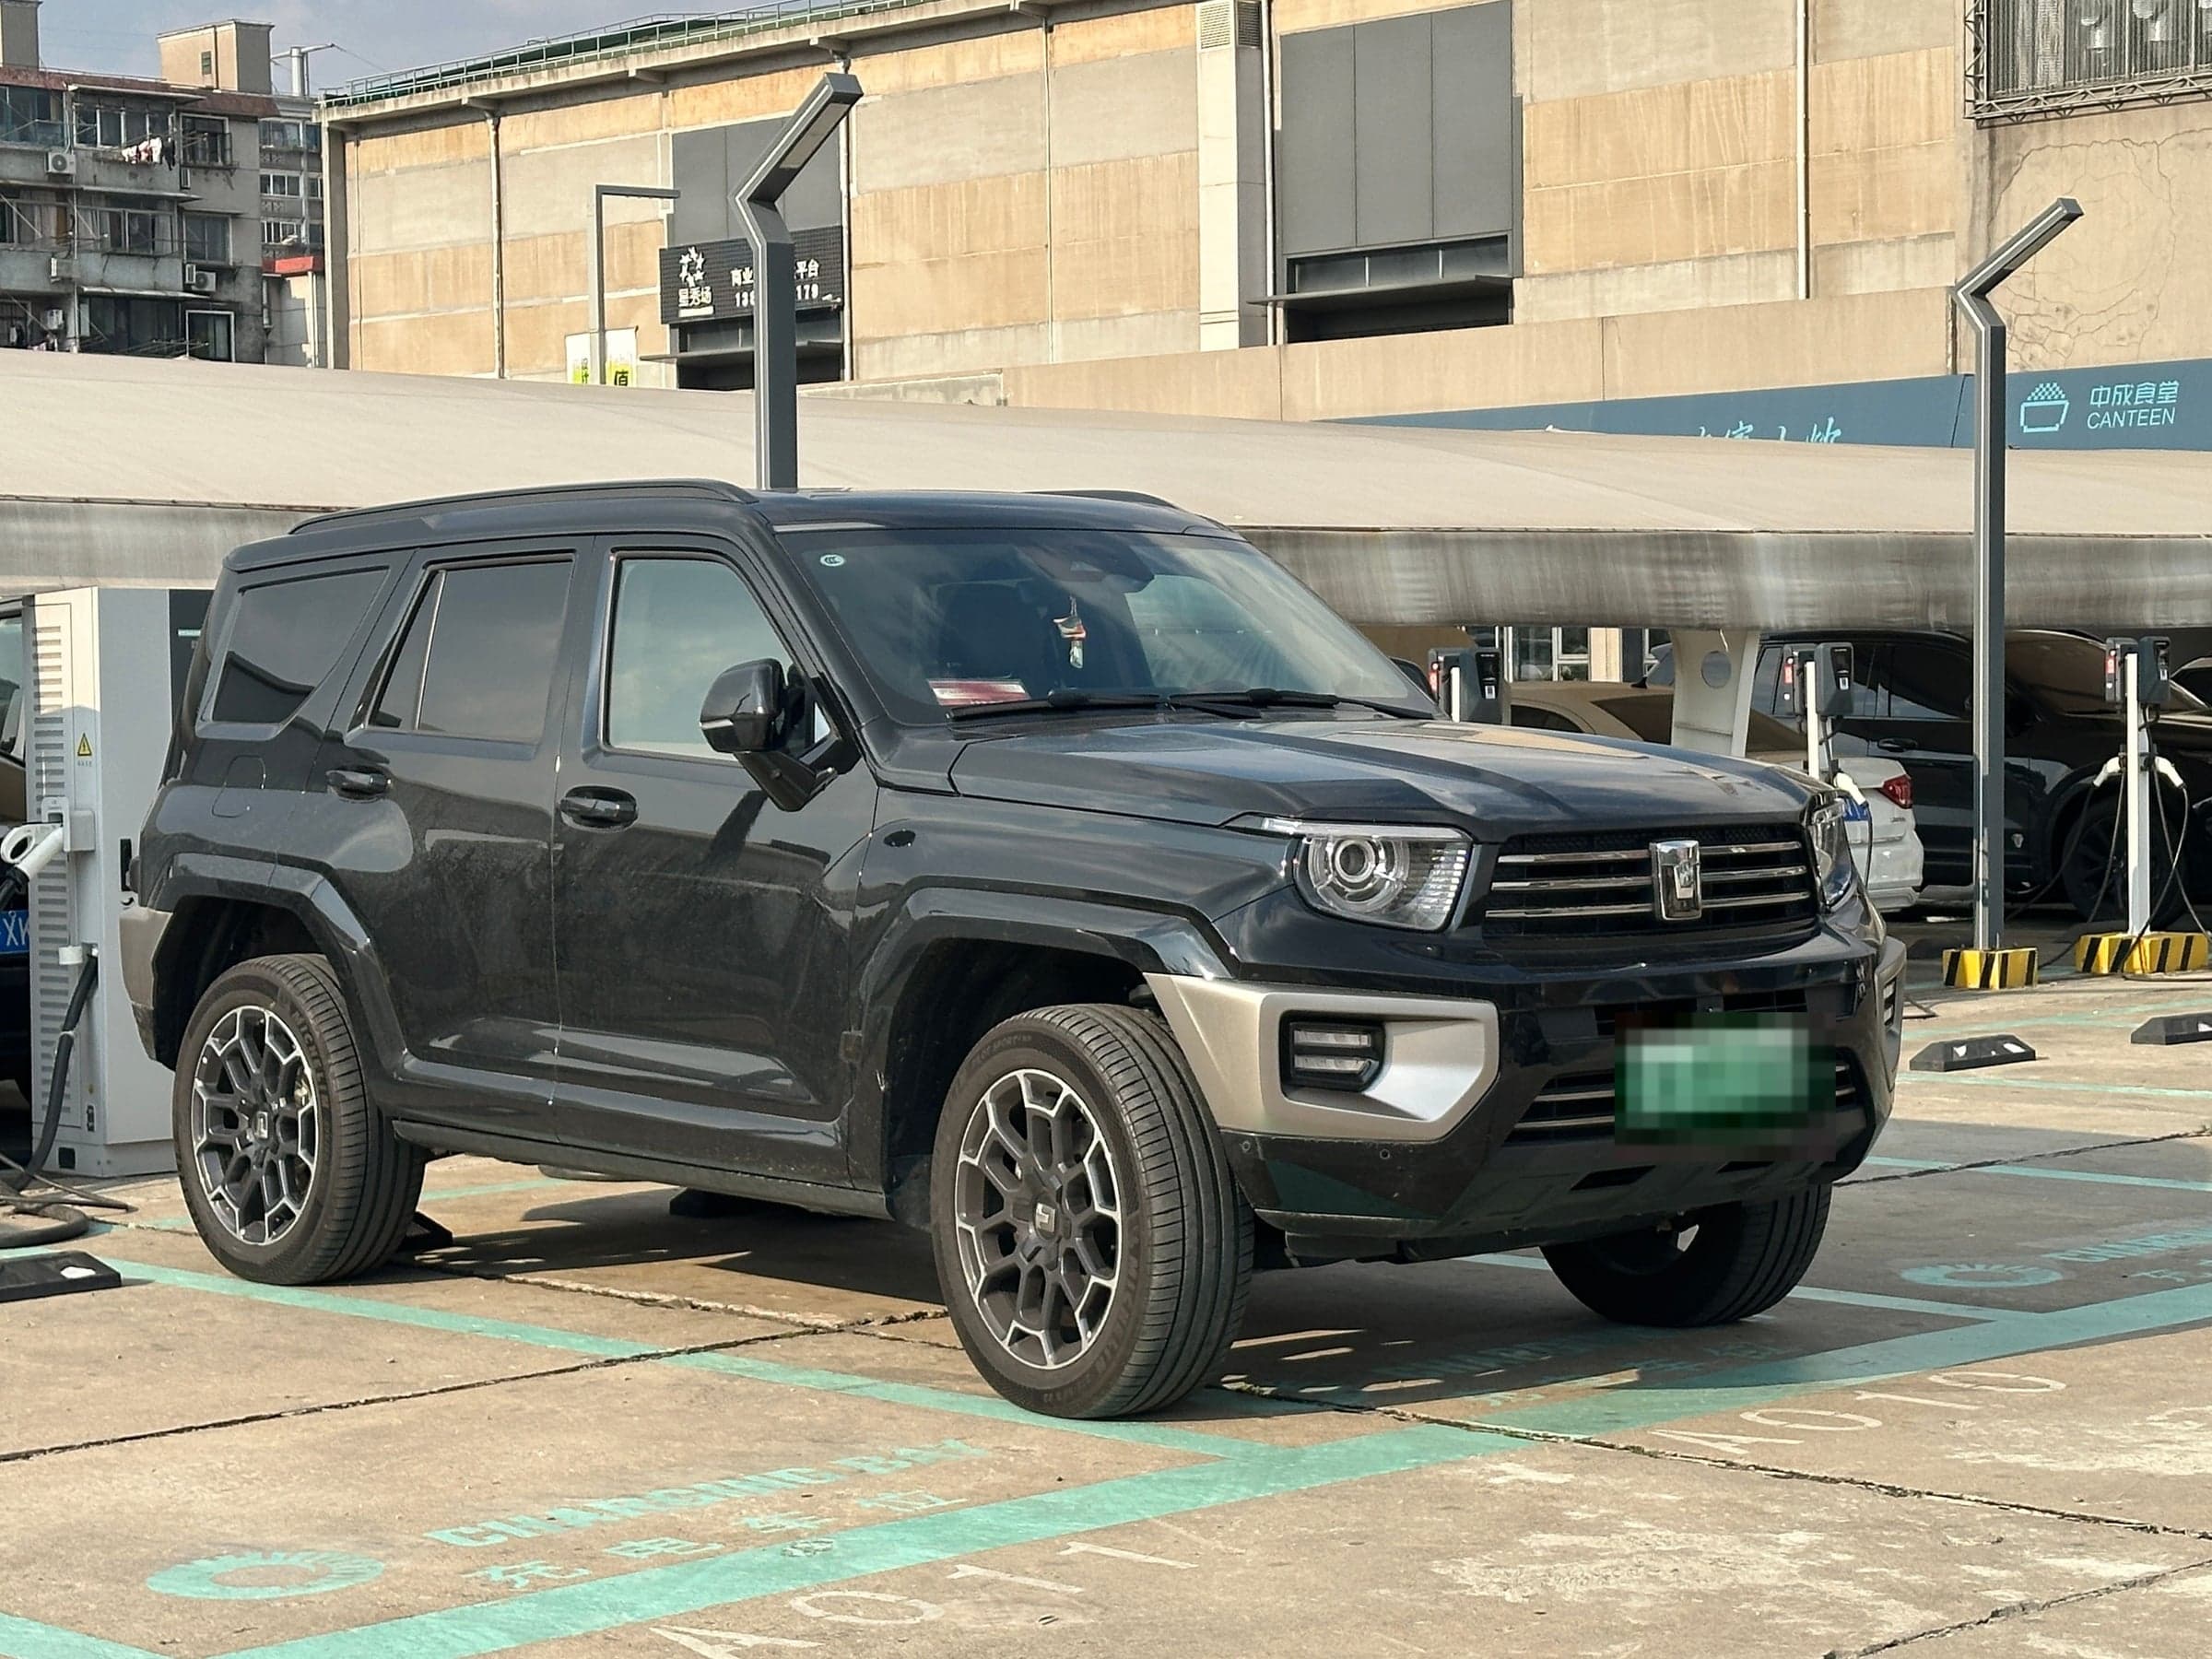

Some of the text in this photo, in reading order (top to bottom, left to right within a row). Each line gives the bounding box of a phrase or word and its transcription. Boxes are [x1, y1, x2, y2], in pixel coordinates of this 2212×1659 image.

[2087, 407, 2176, 429] CANTEEN
[2089, 380, 2180, 407] 中成食堂
[1649, 1371, 2066, 1454] A010
[424, 1466, 838, 1547] CHARGING
[462, 1490, 968, 1590] 充电车位
